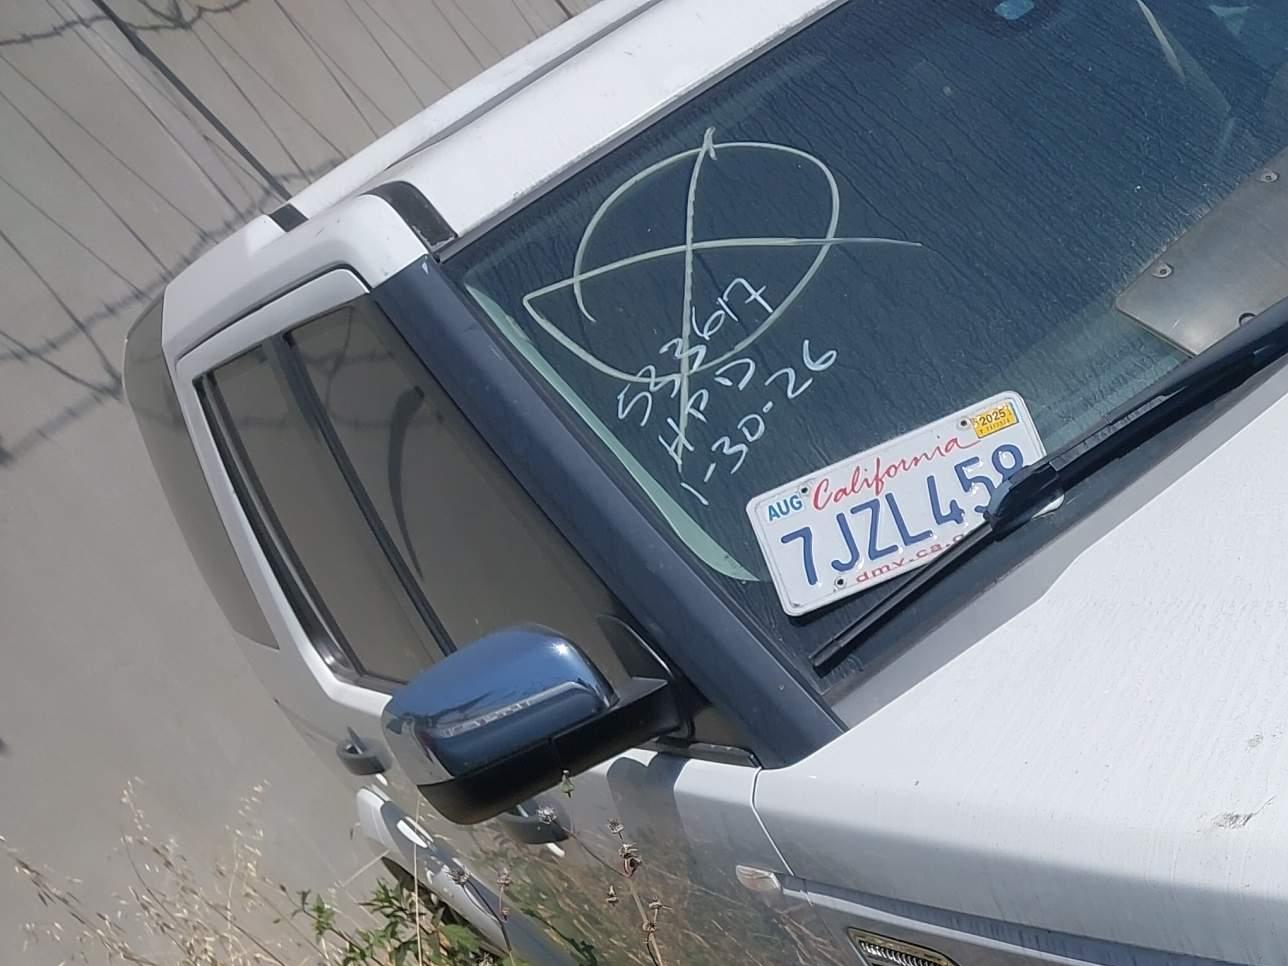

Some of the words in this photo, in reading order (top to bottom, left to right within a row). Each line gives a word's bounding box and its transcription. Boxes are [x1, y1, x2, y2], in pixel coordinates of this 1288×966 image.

[617, 278, 773, 427] 533617
[680, 339, 837, 506] 1-30-26
[979, 409, 1007, 427] 2025
[767, 494, 802, 521] AUG
[812, 434, 981, 510] California
